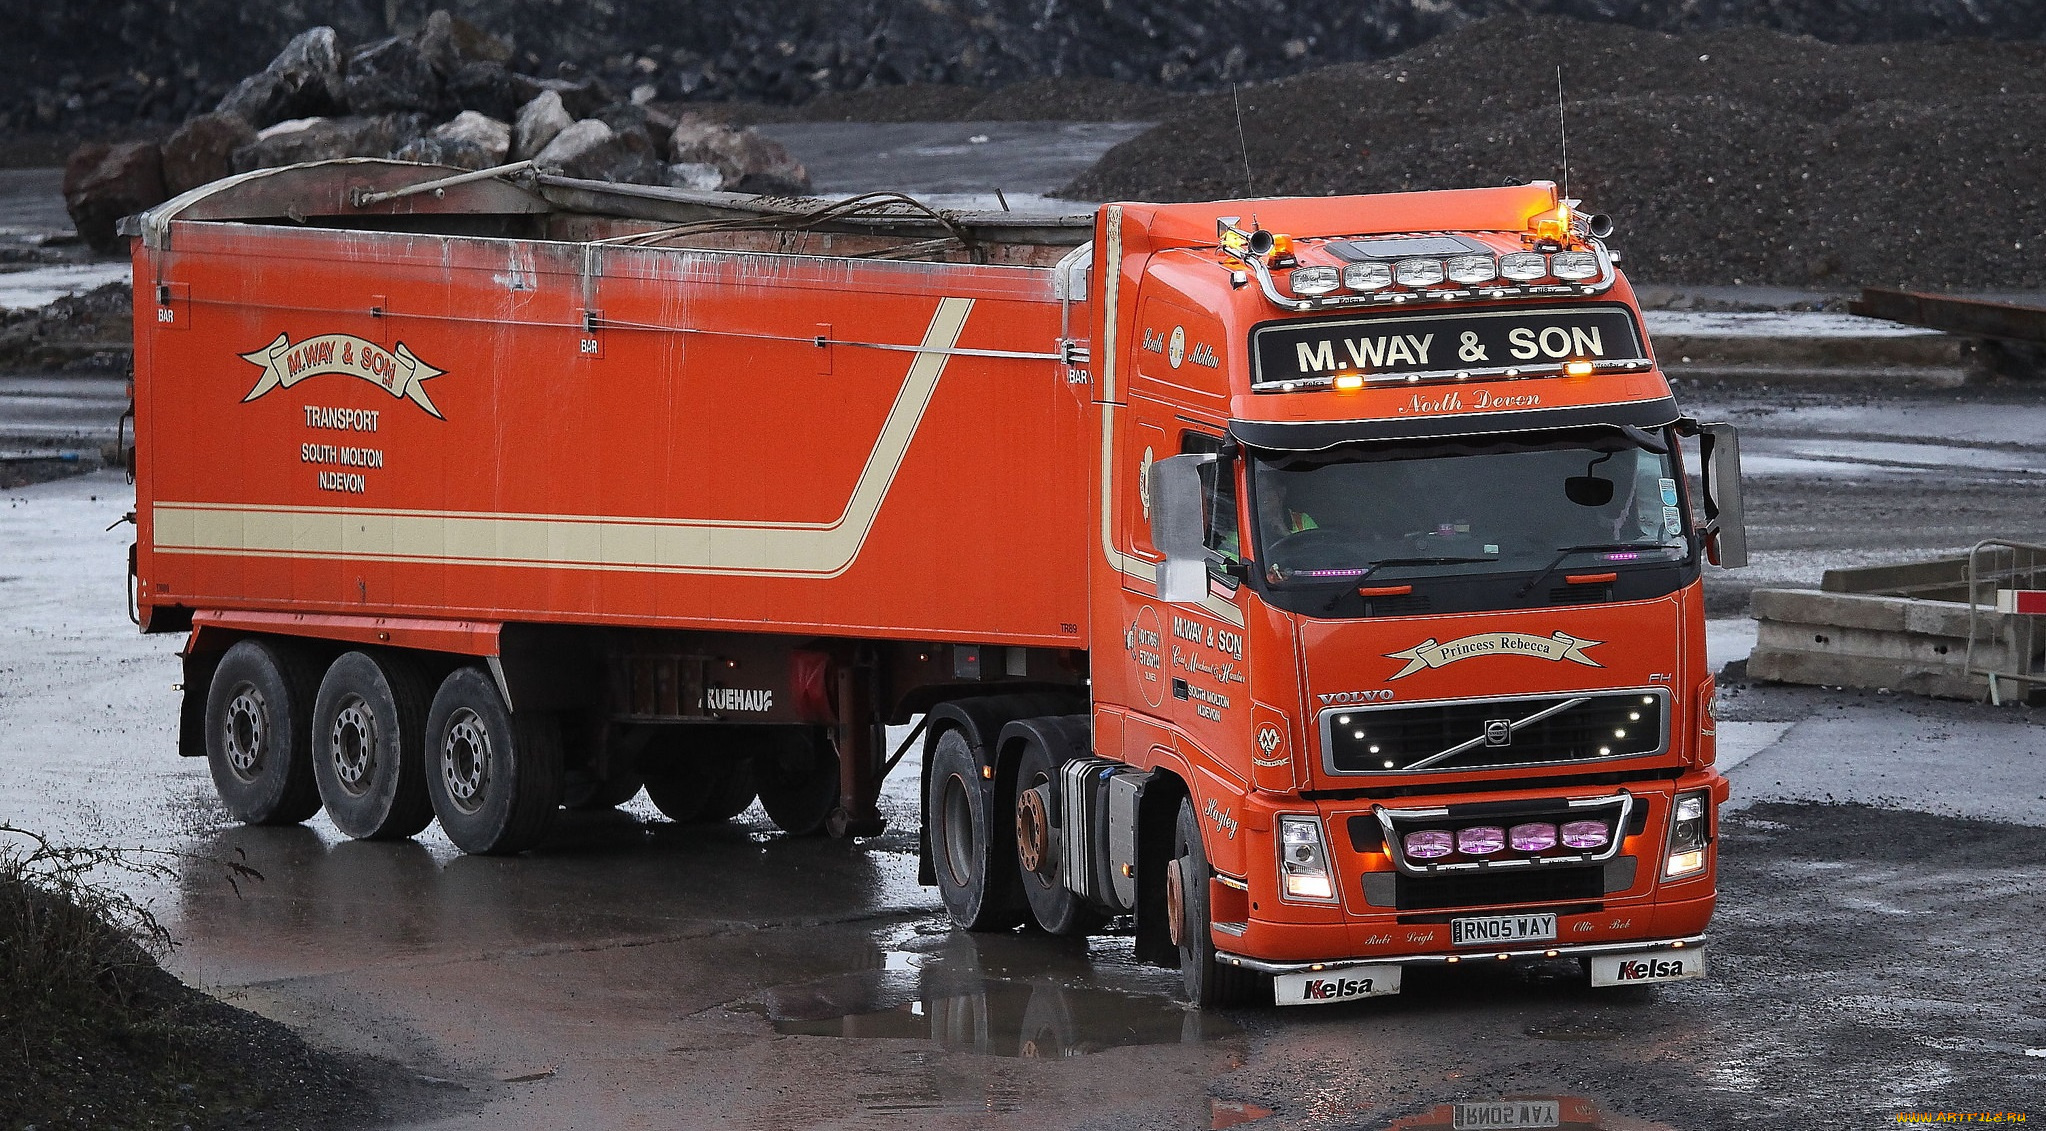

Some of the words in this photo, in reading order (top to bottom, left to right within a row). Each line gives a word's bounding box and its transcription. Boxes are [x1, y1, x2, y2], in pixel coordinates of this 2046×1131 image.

[157, 309, 174, 323] BAR
[580, 339, 598, 354] BAR
[1296, 333, 1434, 373] M.WAY
[1458, 331, 1490, 362] &
[1508, 326, 1604, 360] SON
[287, 341, 336, 377] M.WAY
[342, 341, 354, 366] &
[361, 346, 396, 382] SON
[1069, 369, 1088, 384] BAR
[1398, 391, 1463, 414] North
[1472, 389, 1542, 409] Devon
[304, 405, 380, 432] TRANSPORT
[301, 442, 336, 464] SOUTH
[340, 446, 383, 469] MOLTON
[319, 471, 365, 494] N.DEVON
[1173, 616, 1203, 644] M.WAY
[1206, 626, 1214, 648] &
[1218, 629, 1242, 655] SON
[1440, 640, 1495, 660] Princess
[1500, 637, 1550, 654] Rebecca
[1648, 672, 1672, 684] FH
[1187, 684, 1206, 701] SOUTH
[1206, 690, 1230, 709] MOLTON
[1317, 689, 1394, 705] VOLVO
[1205, 797, 1239, 840] Hayley
[1464, 920, 1512, 940] RN05
[1518, 917, 1552, 936] WAY
[1616, 958, 1684, 981] Kelsa
[1302, 978, 1374, 1000] Kelsa
